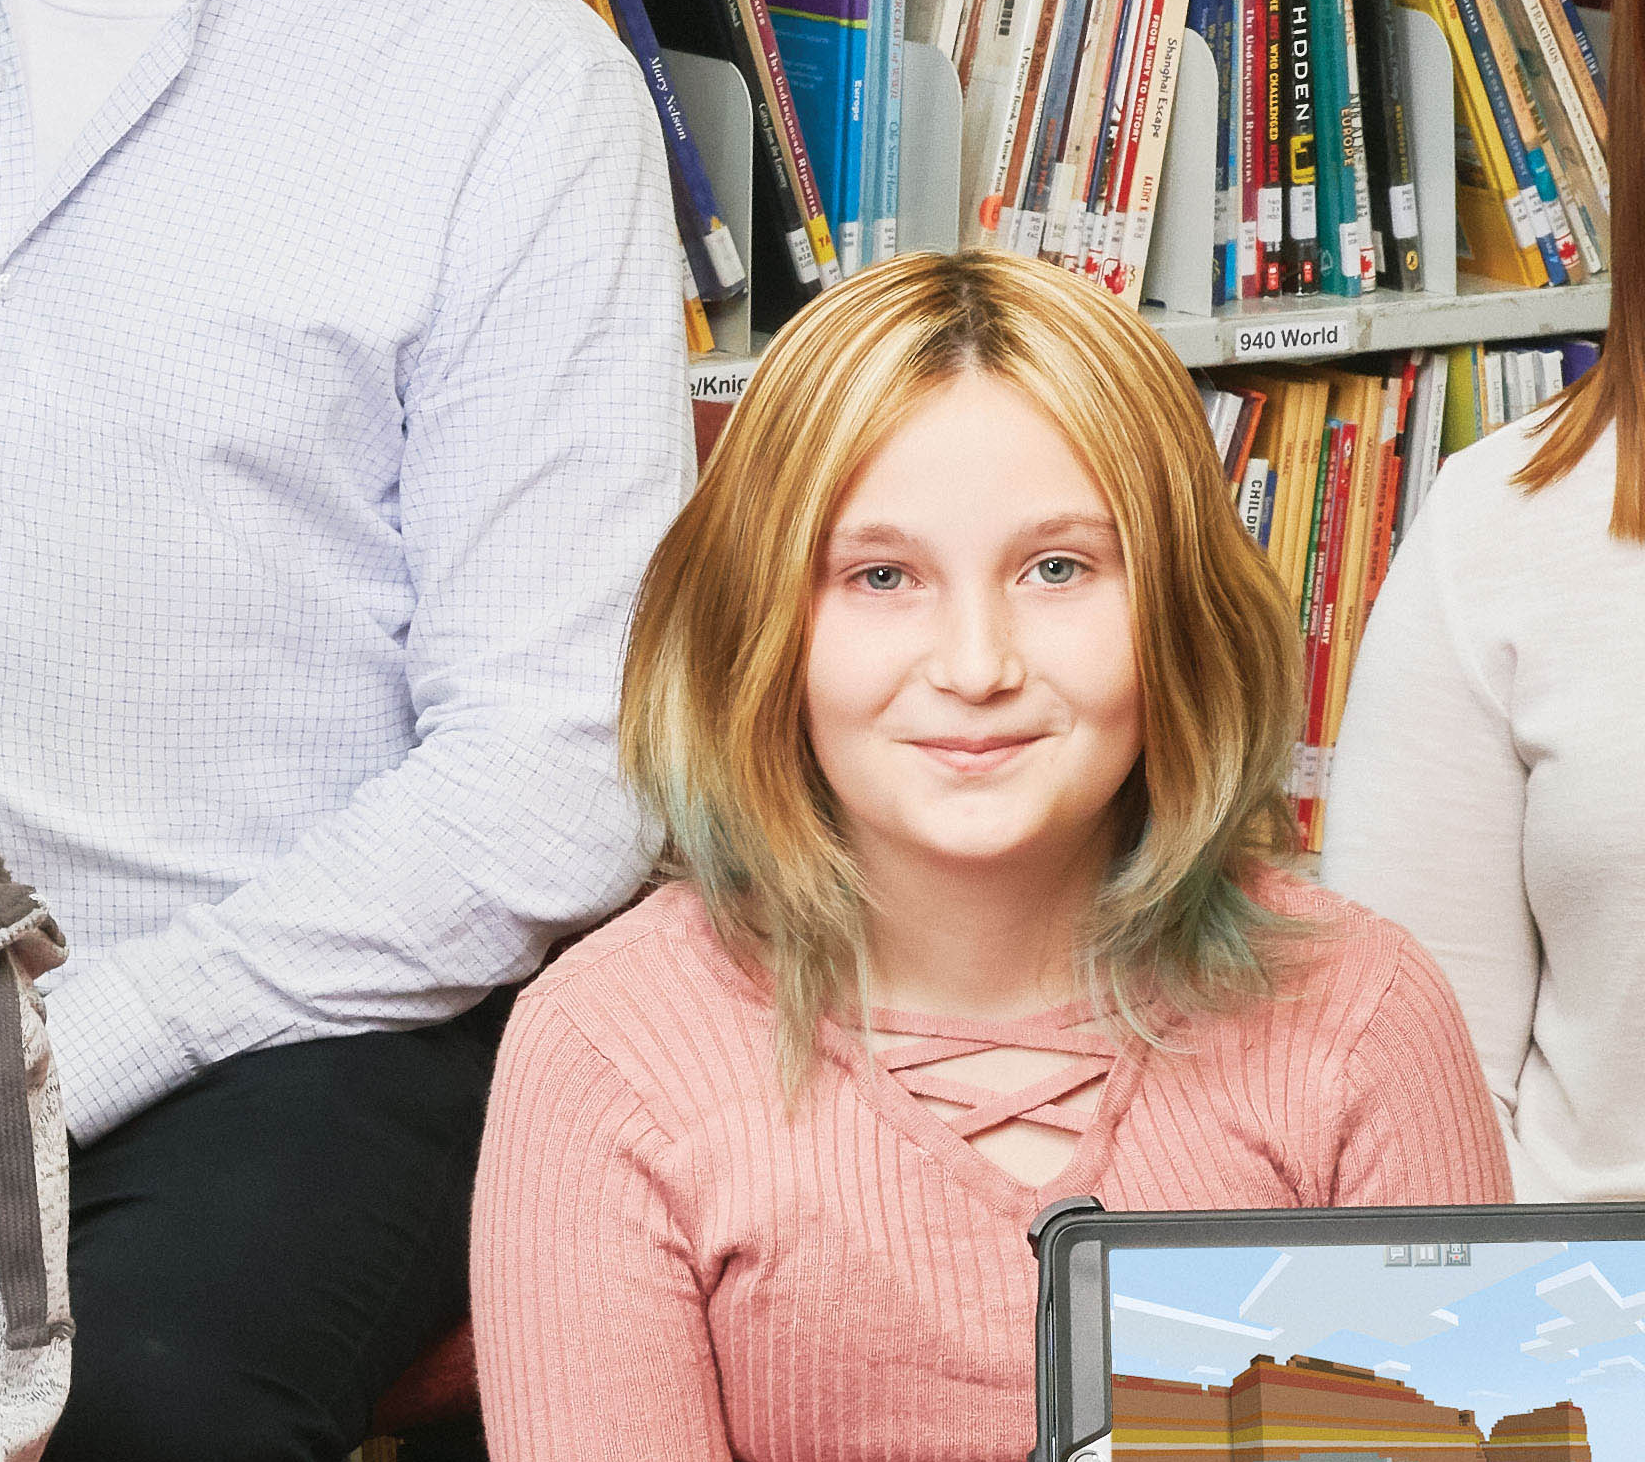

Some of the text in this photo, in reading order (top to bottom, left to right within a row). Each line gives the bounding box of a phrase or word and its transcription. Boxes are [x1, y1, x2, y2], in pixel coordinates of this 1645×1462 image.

[765, 51, 780, 73] The
[1129, 14, 1161, 143] FROM VIMY TO VICTORY
[1150, 38, 1179, 139] Shanghai Escape
[1269, 44, 1278, 69] WHO
[1291, 6, 1310, 123] HIDDEN
[648, 56, 688, 141] Mary Nelson
[1340, 108, 1353, 167] EUROPE
[1239, 325, 1339, 350] 940 World
